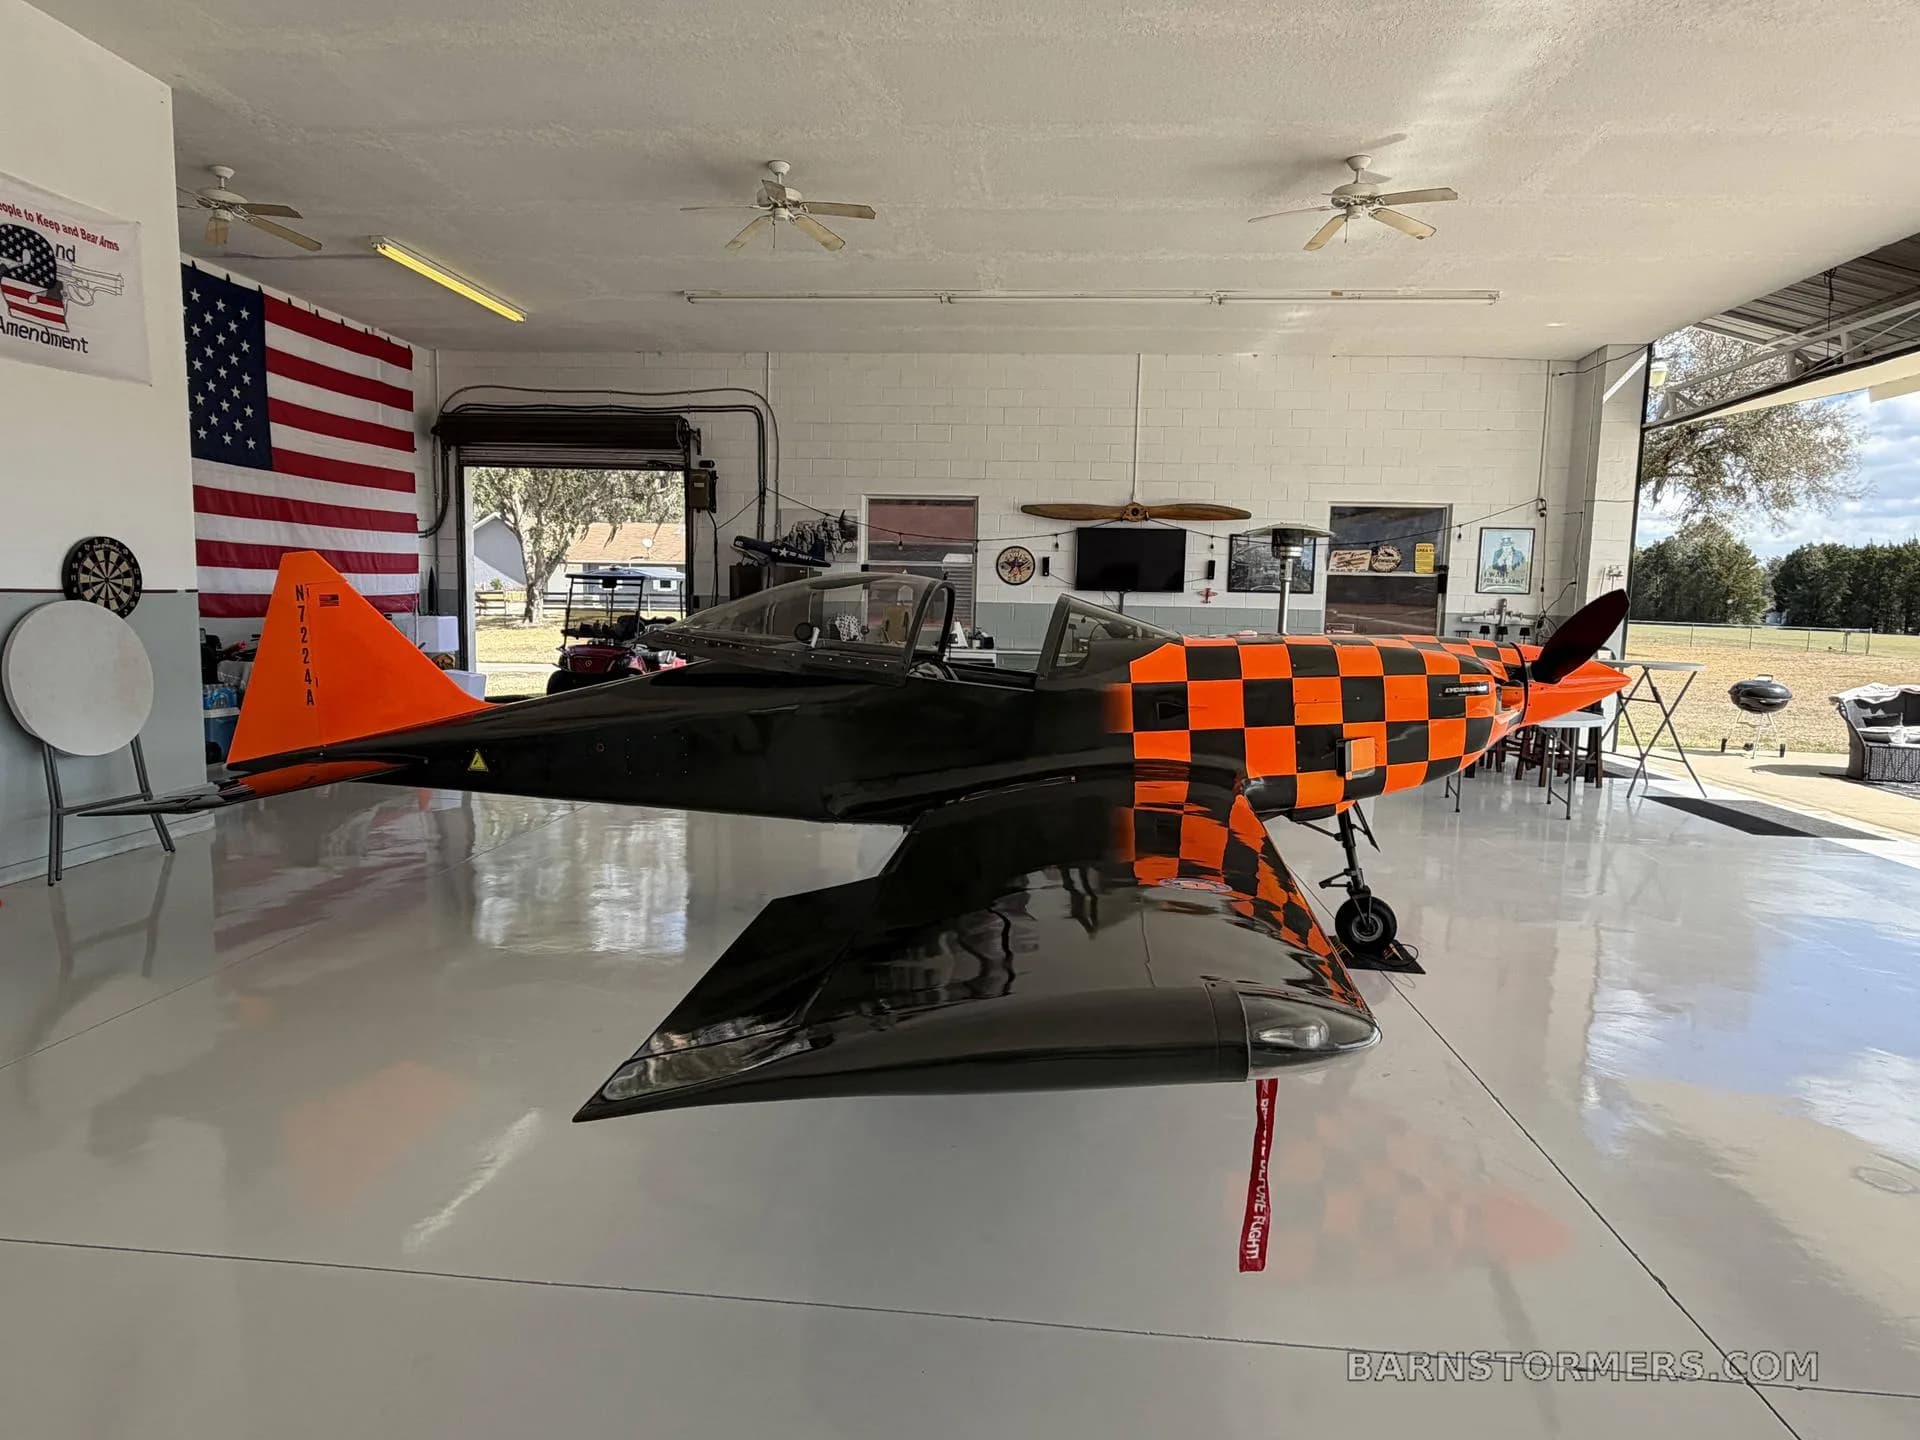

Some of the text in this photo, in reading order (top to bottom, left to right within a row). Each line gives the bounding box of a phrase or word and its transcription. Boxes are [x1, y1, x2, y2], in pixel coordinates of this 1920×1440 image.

[0, 202, 120, 251] eople to Keep and Bear Arms
[0, 315, 89, 353] Amendment
